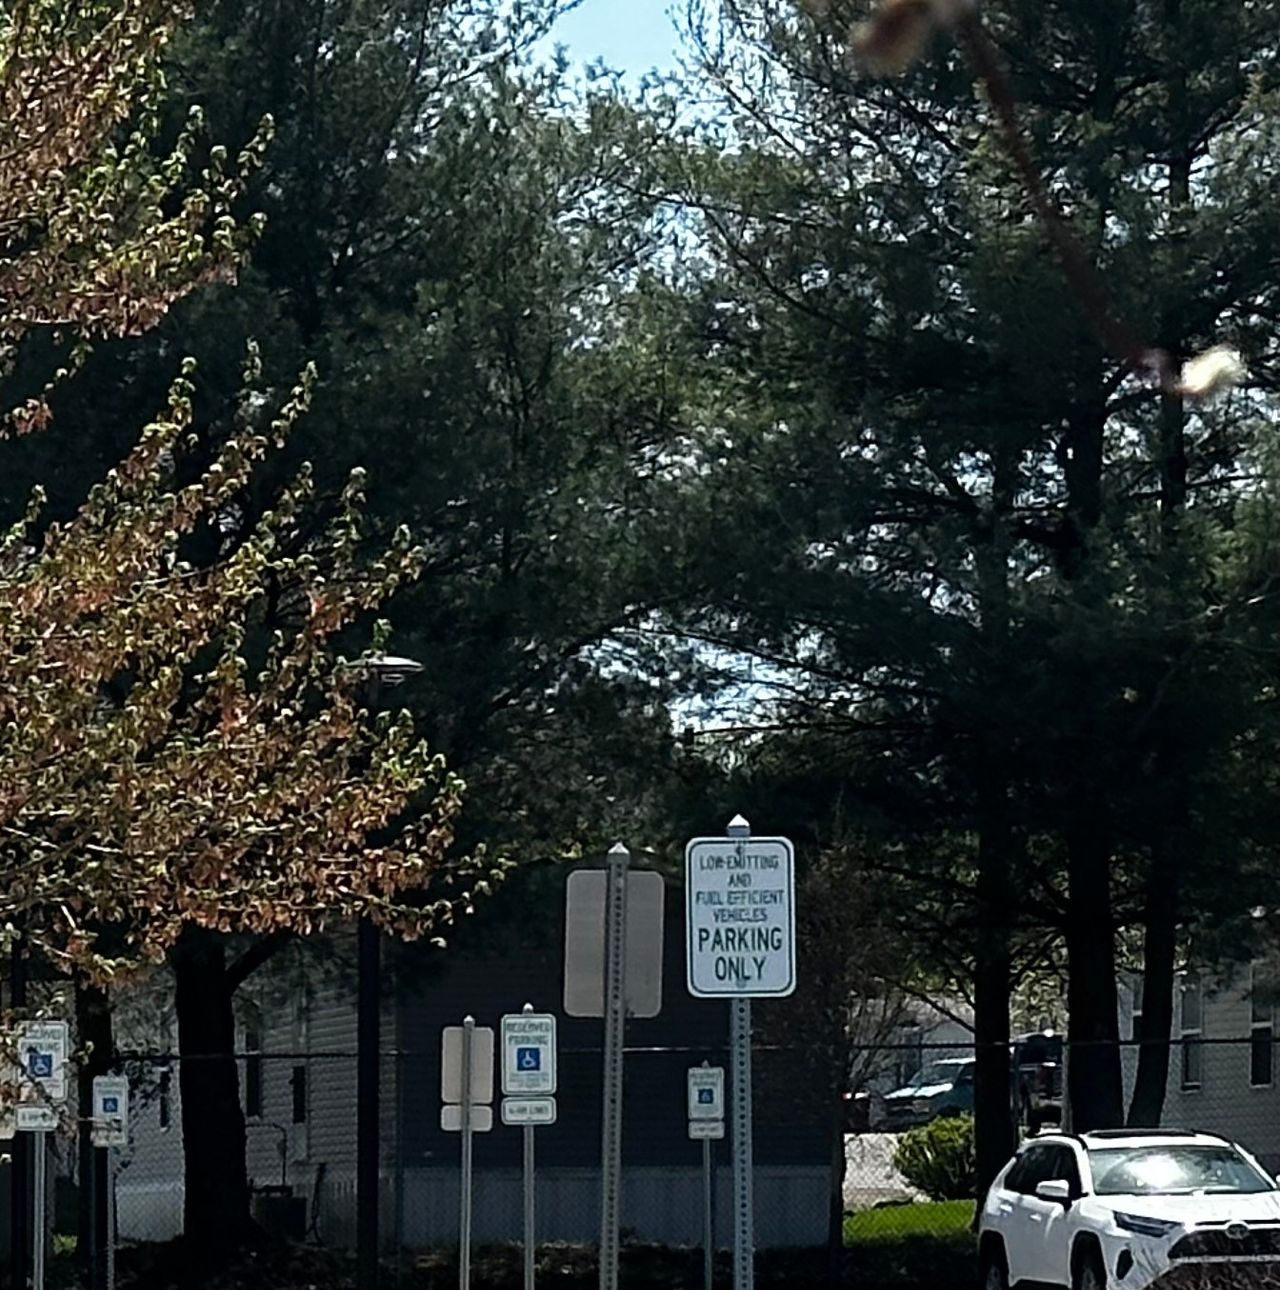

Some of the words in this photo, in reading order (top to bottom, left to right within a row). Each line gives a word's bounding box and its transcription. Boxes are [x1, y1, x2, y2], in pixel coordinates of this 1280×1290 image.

[728, 872, 752, 887] AND
[696, 891, 723, 906] FUEL
[727, 889, 785, 906] EFFICIENT
[713, 908, 768, 923] VEHICLES
[698, 926, 783, 952] PARKING
[714, 956, 767, 981] ONLY
